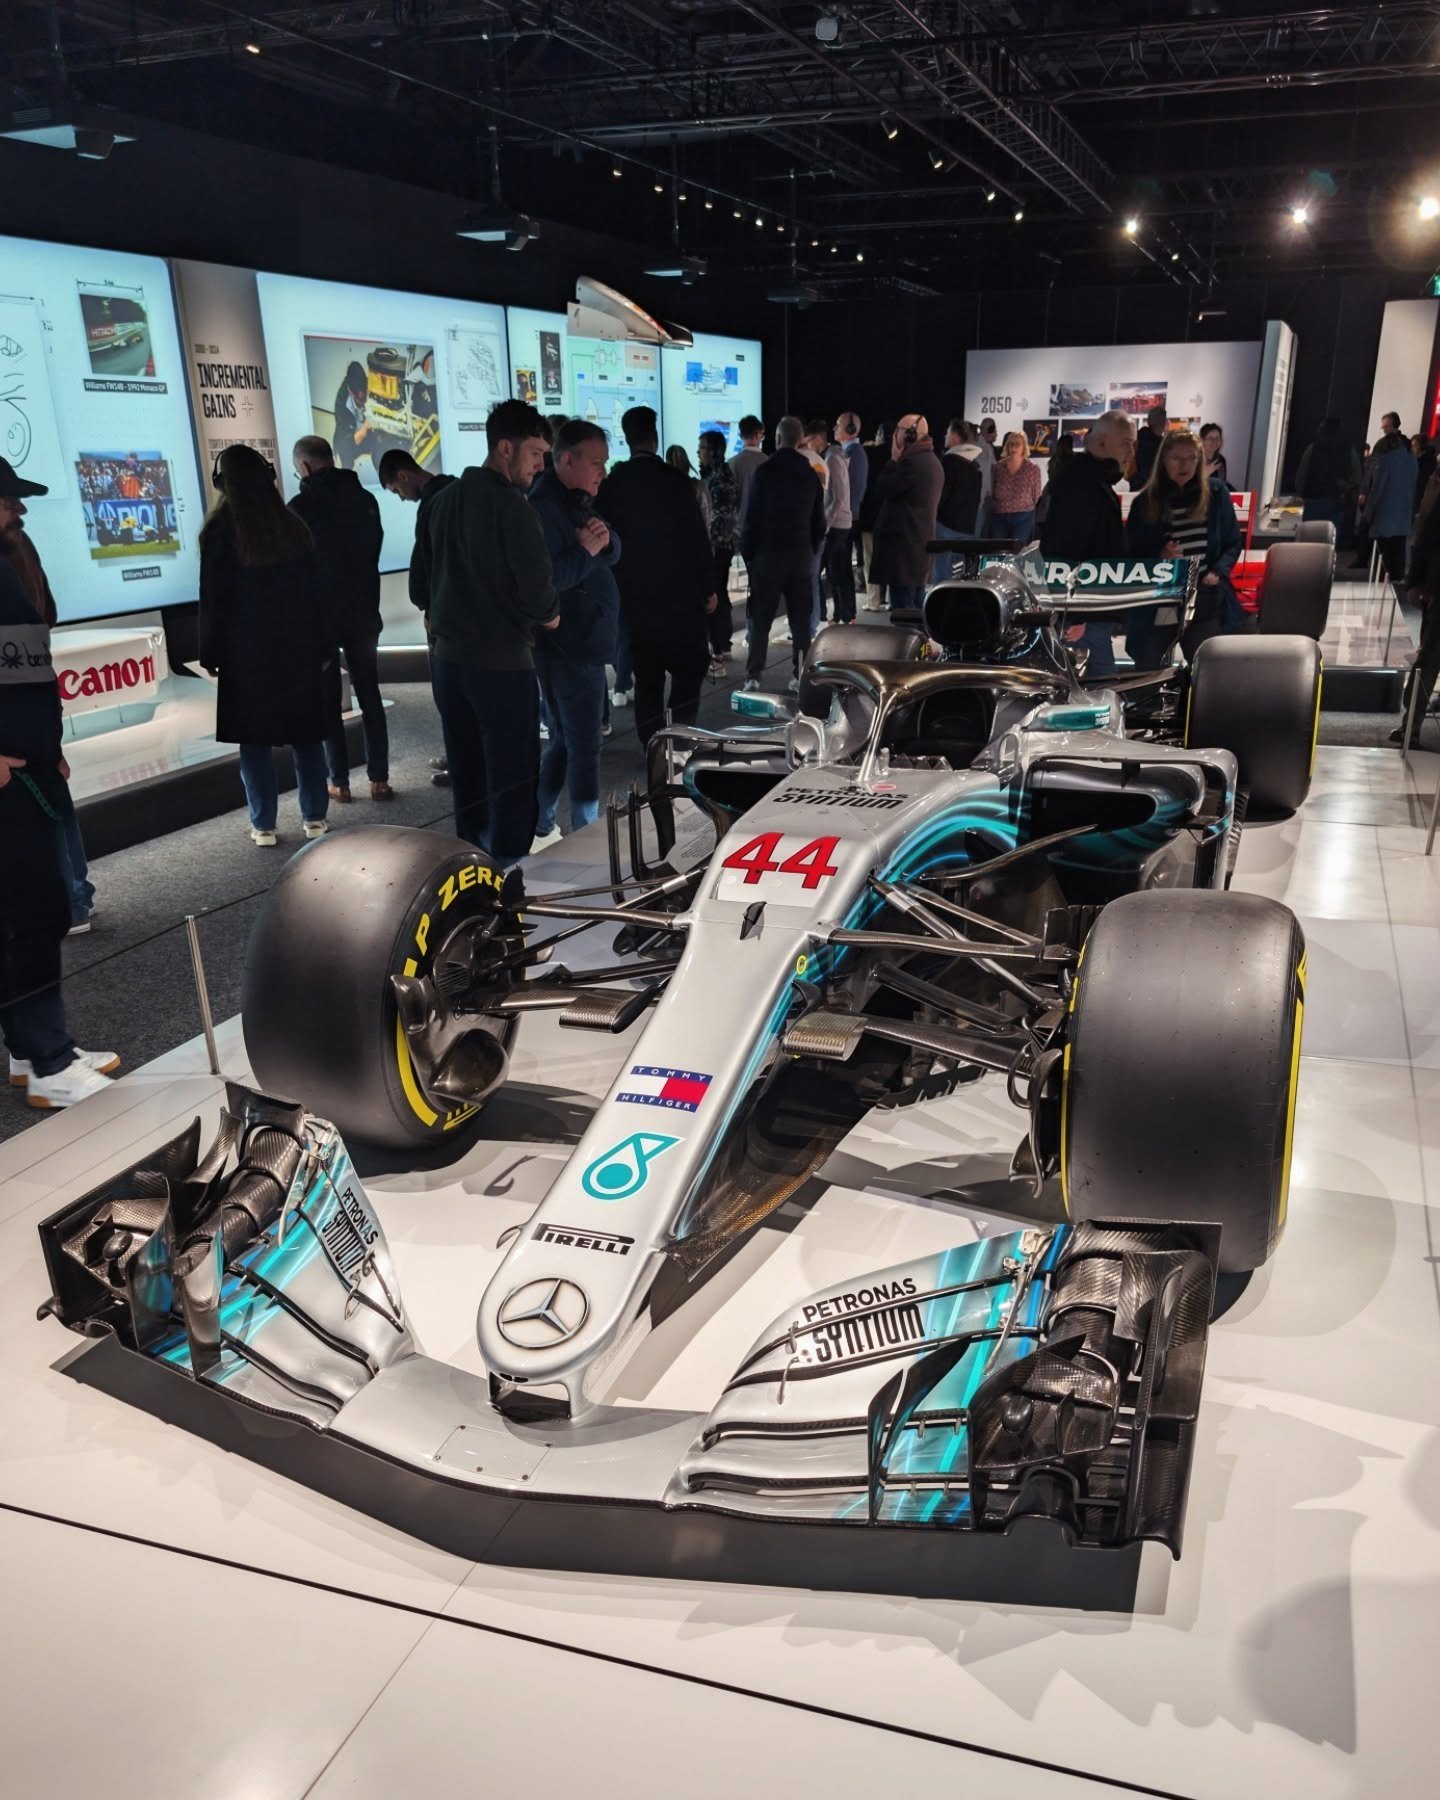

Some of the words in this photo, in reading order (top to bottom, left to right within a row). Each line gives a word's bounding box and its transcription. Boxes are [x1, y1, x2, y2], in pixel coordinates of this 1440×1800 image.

[197, 363, 268, 390] INCREMENTAL
[202, 393, 237, 418] GAINS
[981, 396, 1012, 414] 2050
[57, 654, 155, 700] Canon
[773, 793, 904, 809] SYNTIUM
[786, 787, 910, 799] PETRONAS
[722, 831, 842, 889] 44
[638, 1066, 707, 1082] TOMMY
[621, 1094, 692, 1111] HILFIGER
[341, 1187, 379, 1245] PETRONAS
[529, 1222, 636, 1256] PIRELLI
[801, 1277, 917, 1323] PETRONAS
[812, 1303, 926, 1363] SYNTIUM
